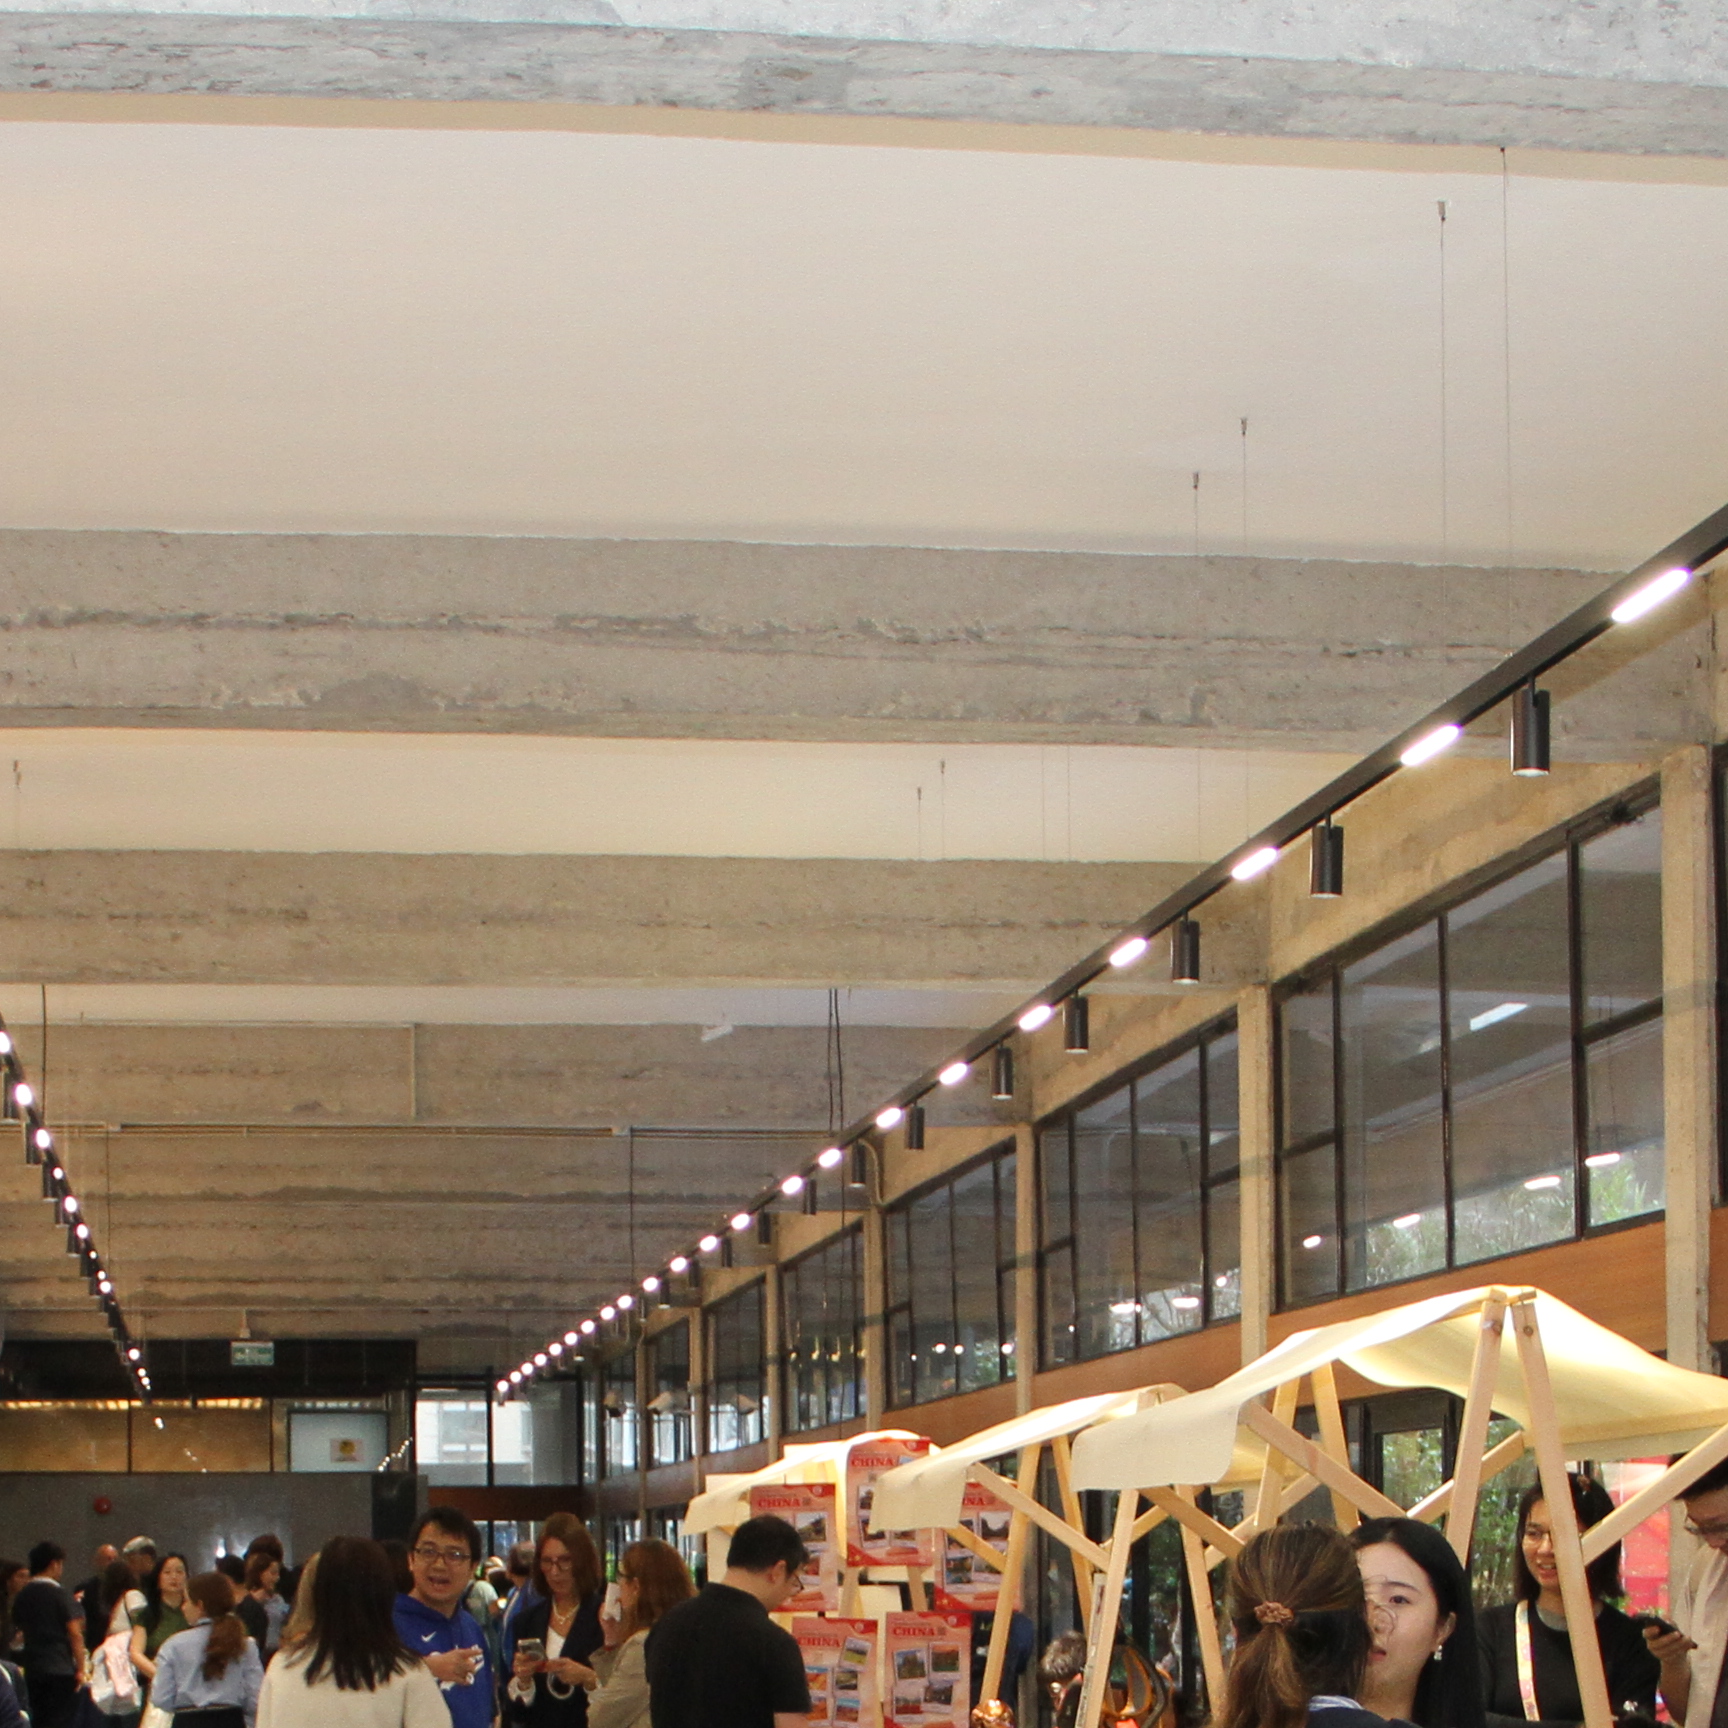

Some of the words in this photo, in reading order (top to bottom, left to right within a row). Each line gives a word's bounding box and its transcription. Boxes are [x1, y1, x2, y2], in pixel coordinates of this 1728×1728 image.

[851, 1456, 894, 1468] CHINA
[758, 1496, 801, 1508] CHINA
[893, 1626, 936, 1638] CHINA
[797, 1635, 841, 1648] CHINA
